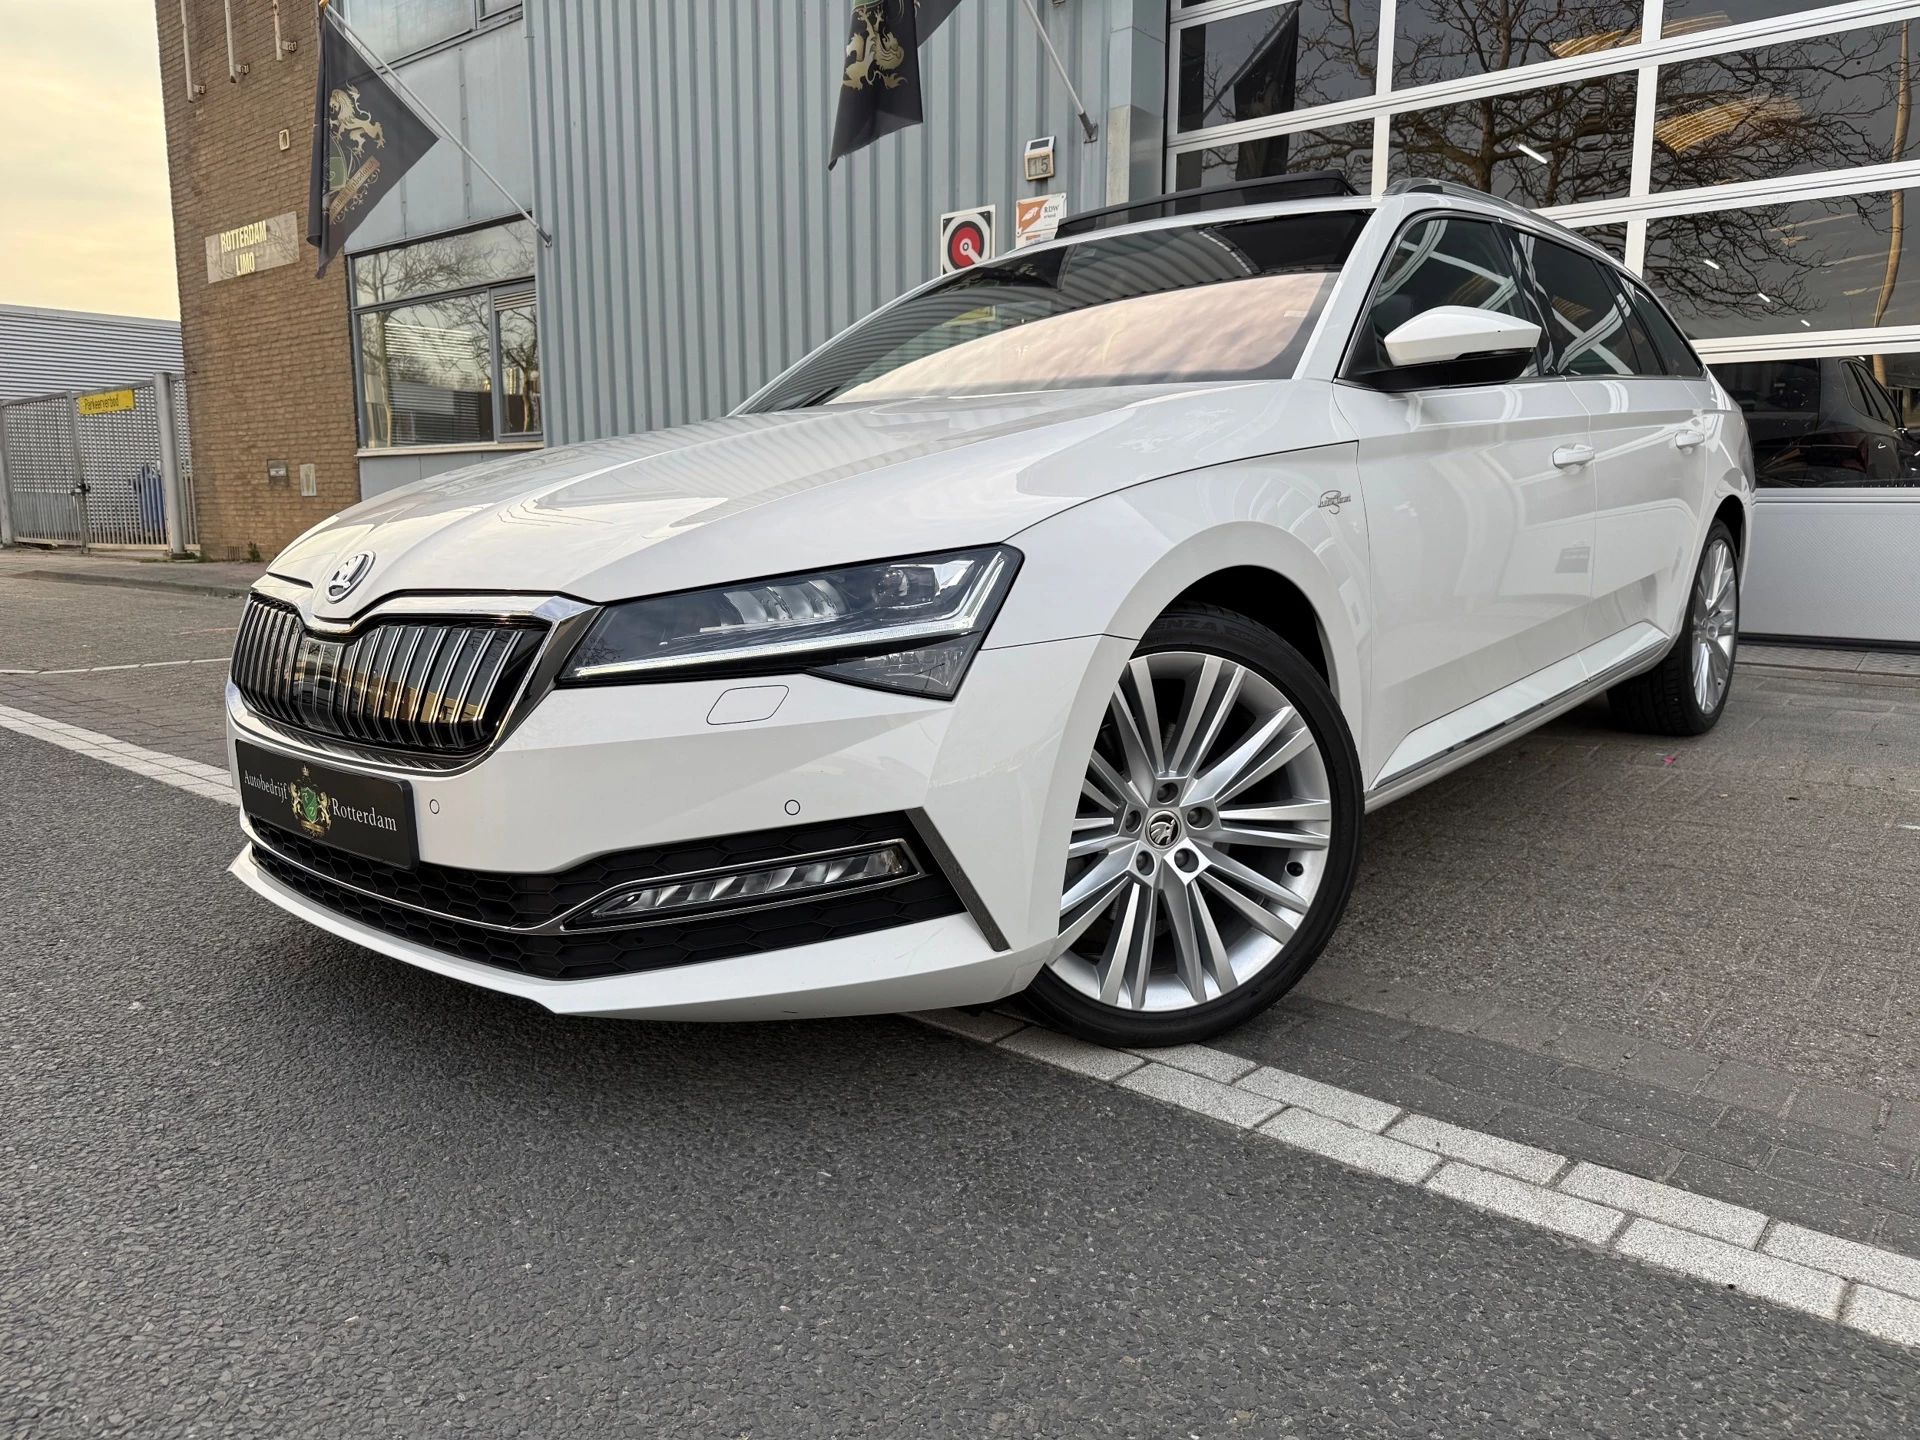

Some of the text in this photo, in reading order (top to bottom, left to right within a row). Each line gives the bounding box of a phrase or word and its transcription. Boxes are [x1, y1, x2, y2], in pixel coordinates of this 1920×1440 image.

[1032, 157, 1049, 174] 15
[1044, 204, 1060, 214] RDW
[220, 220, 267, 253] ROTTERDAM
[235, 252, 255, 276] LIMO
[84, 394, 119, 410] Parkeerverbod
[1150, 619, 1217, 632] ENZA
[244, 769, 288, 804] Autobedrijf
[332, 797, 397, 832] Rotterdam
